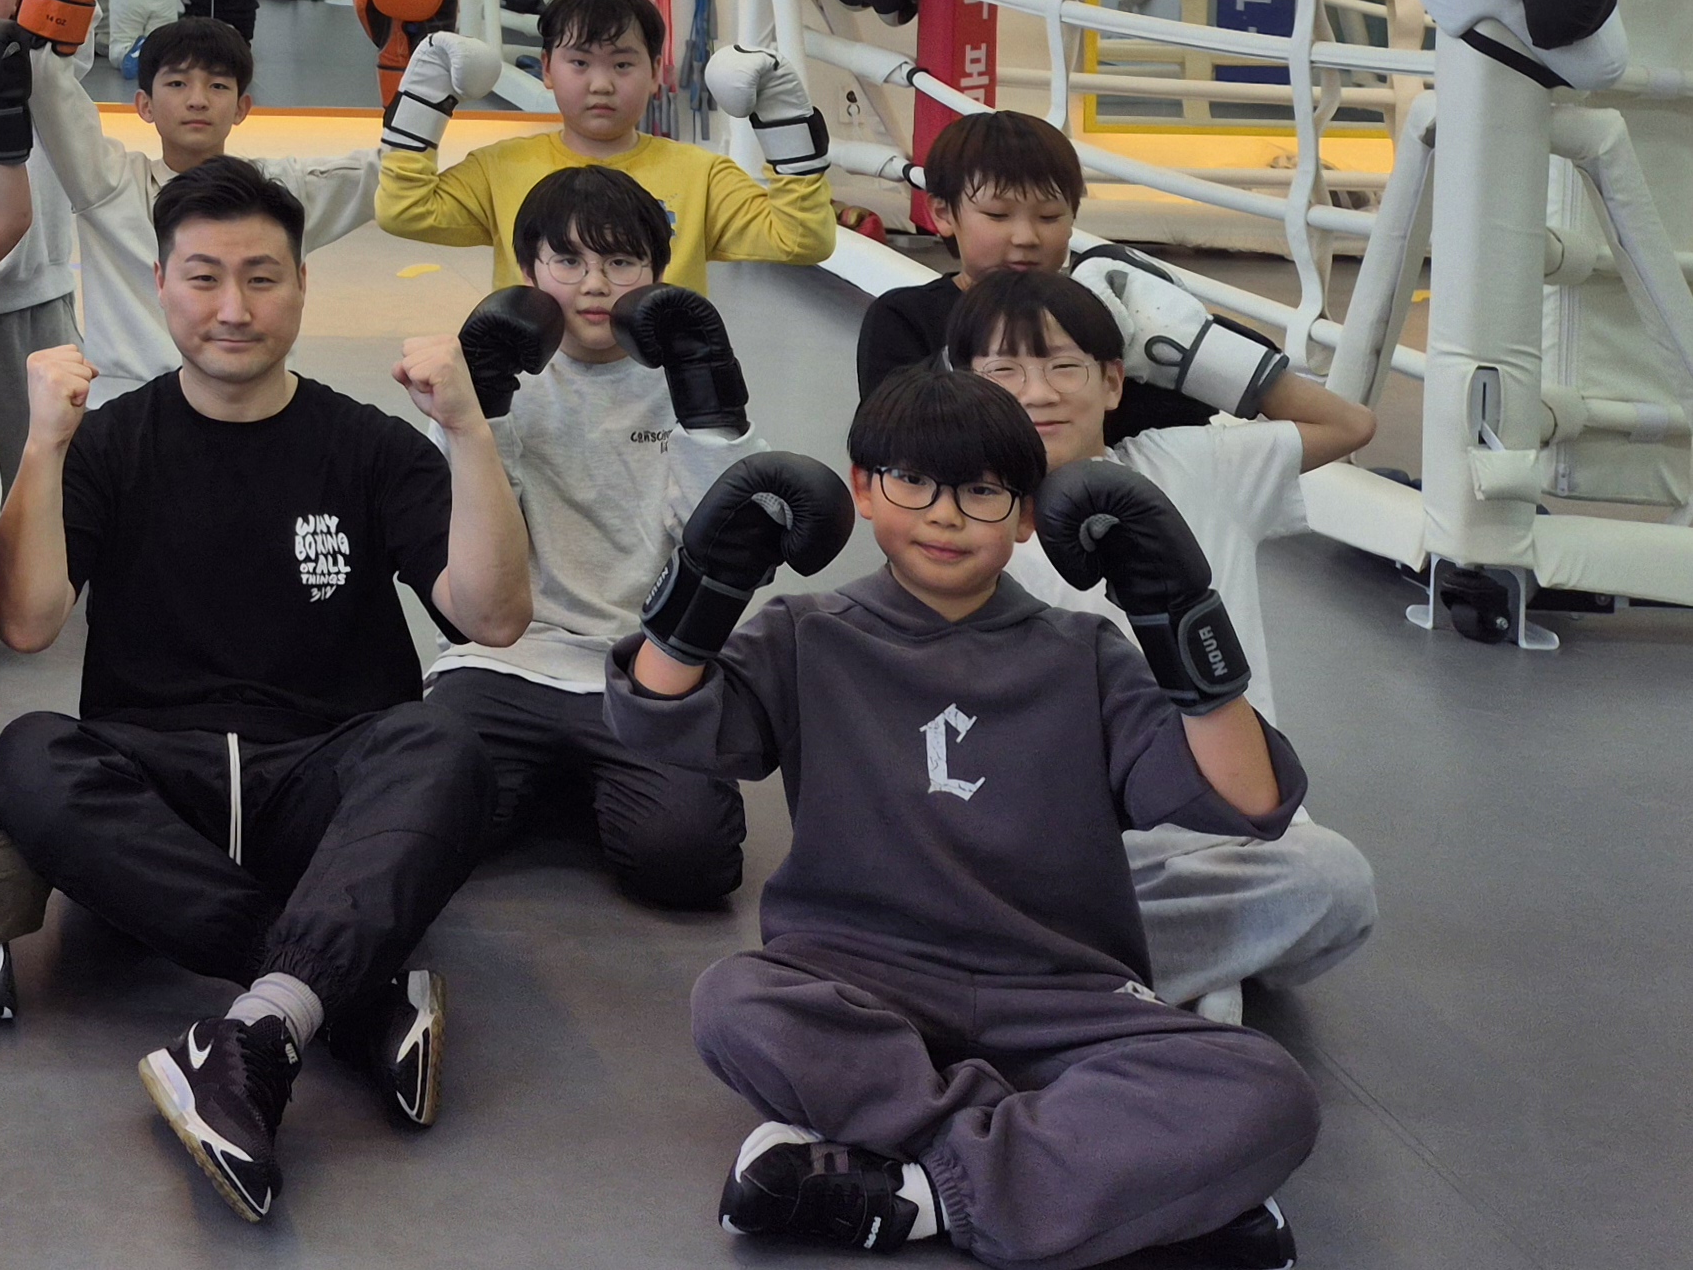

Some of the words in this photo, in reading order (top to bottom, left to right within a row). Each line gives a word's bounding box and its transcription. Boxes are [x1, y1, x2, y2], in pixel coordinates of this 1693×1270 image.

[295, 513, 340, 536] WHY
[294, 532, 350, 561] BOXING
[315, 554, 352, 574] ALL
[300, 573, 347, 585] THINGS
